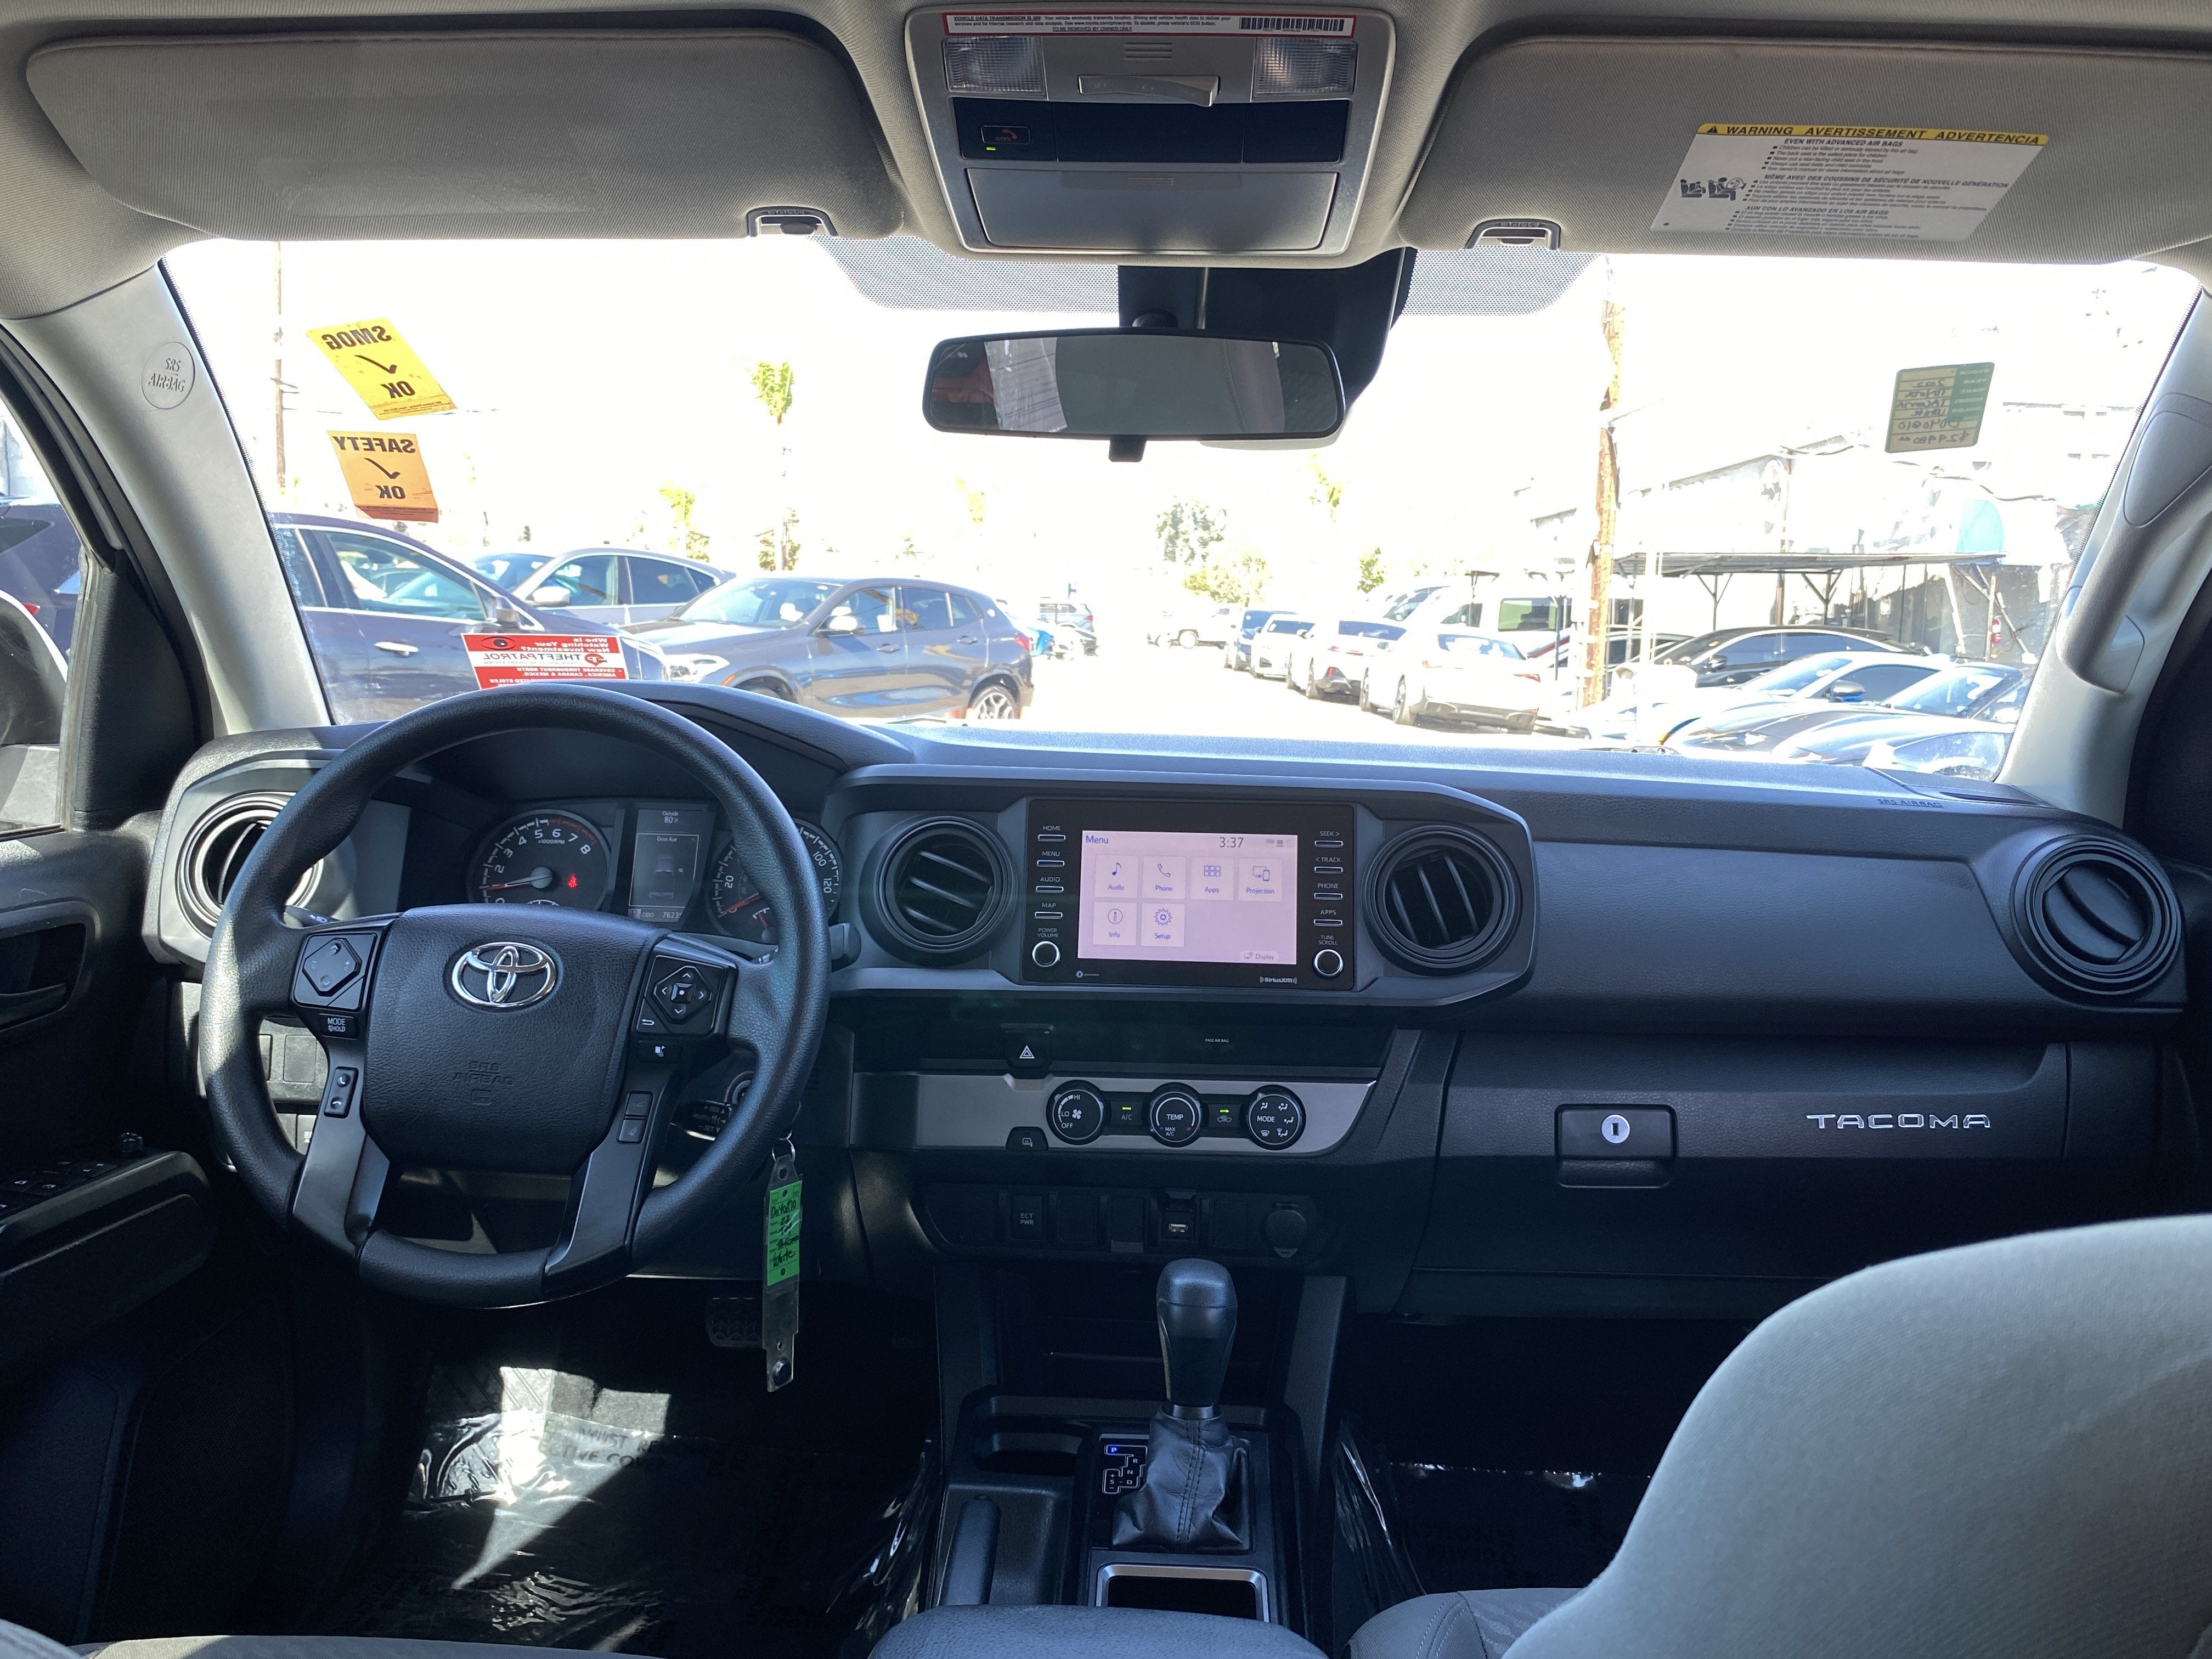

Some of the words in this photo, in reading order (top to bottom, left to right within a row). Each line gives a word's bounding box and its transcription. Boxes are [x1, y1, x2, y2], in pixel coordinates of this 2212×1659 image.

[1726, 127, 1793, 135] WARNING
[1805, 127, 1928, 139] AVERTISSEMENT
[1935, 131, 2040, 144] ADVERTENCIA
[166, 357, 181, 372] SRS
[148, 373, 185, 392] AIRBAG
[534, 829, 543, 839] 5
[552, 828, 561, 838] 6
[568, 833, 578, 842] 7
[518, 836, 527, 845] 4
[1086, 836, 1109, 844] Menu
[1219, 837, 1244, 848] 3:37
[503, 848, 514, 858] 3
[580, 844, 591, 855] 8
[812, 850, 827, 866] 100
[494, 865, 505, 873] 2
[724, 875, 734, 888] 20
[823, 877, 832, 894] 120
[328, 1017, 346, 1025] MODE
[1806, 1114, 1990, 1129] TACOMA
